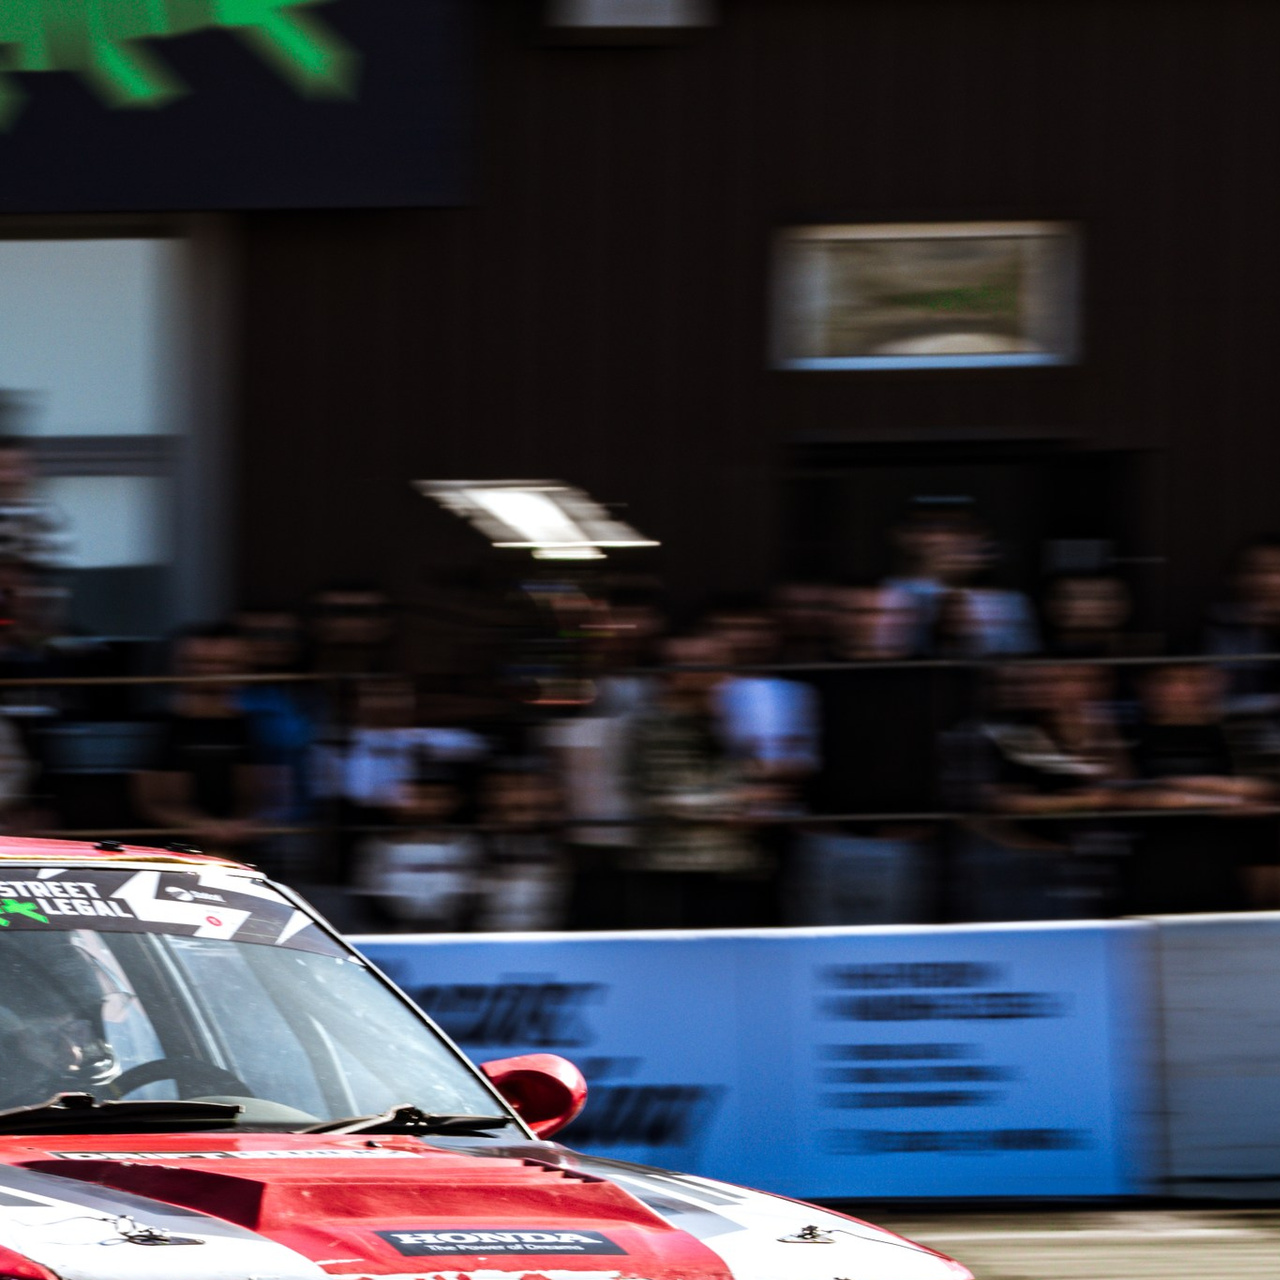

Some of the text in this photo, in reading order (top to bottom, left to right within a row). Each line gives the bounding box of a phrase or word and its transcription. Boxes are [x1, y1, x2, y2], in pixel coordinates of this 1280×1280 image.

[36, 897, 135, 918] LEGAL
[391, 1232, 603, 1244] HONDA
[425, 1244, 456, 1252] The
